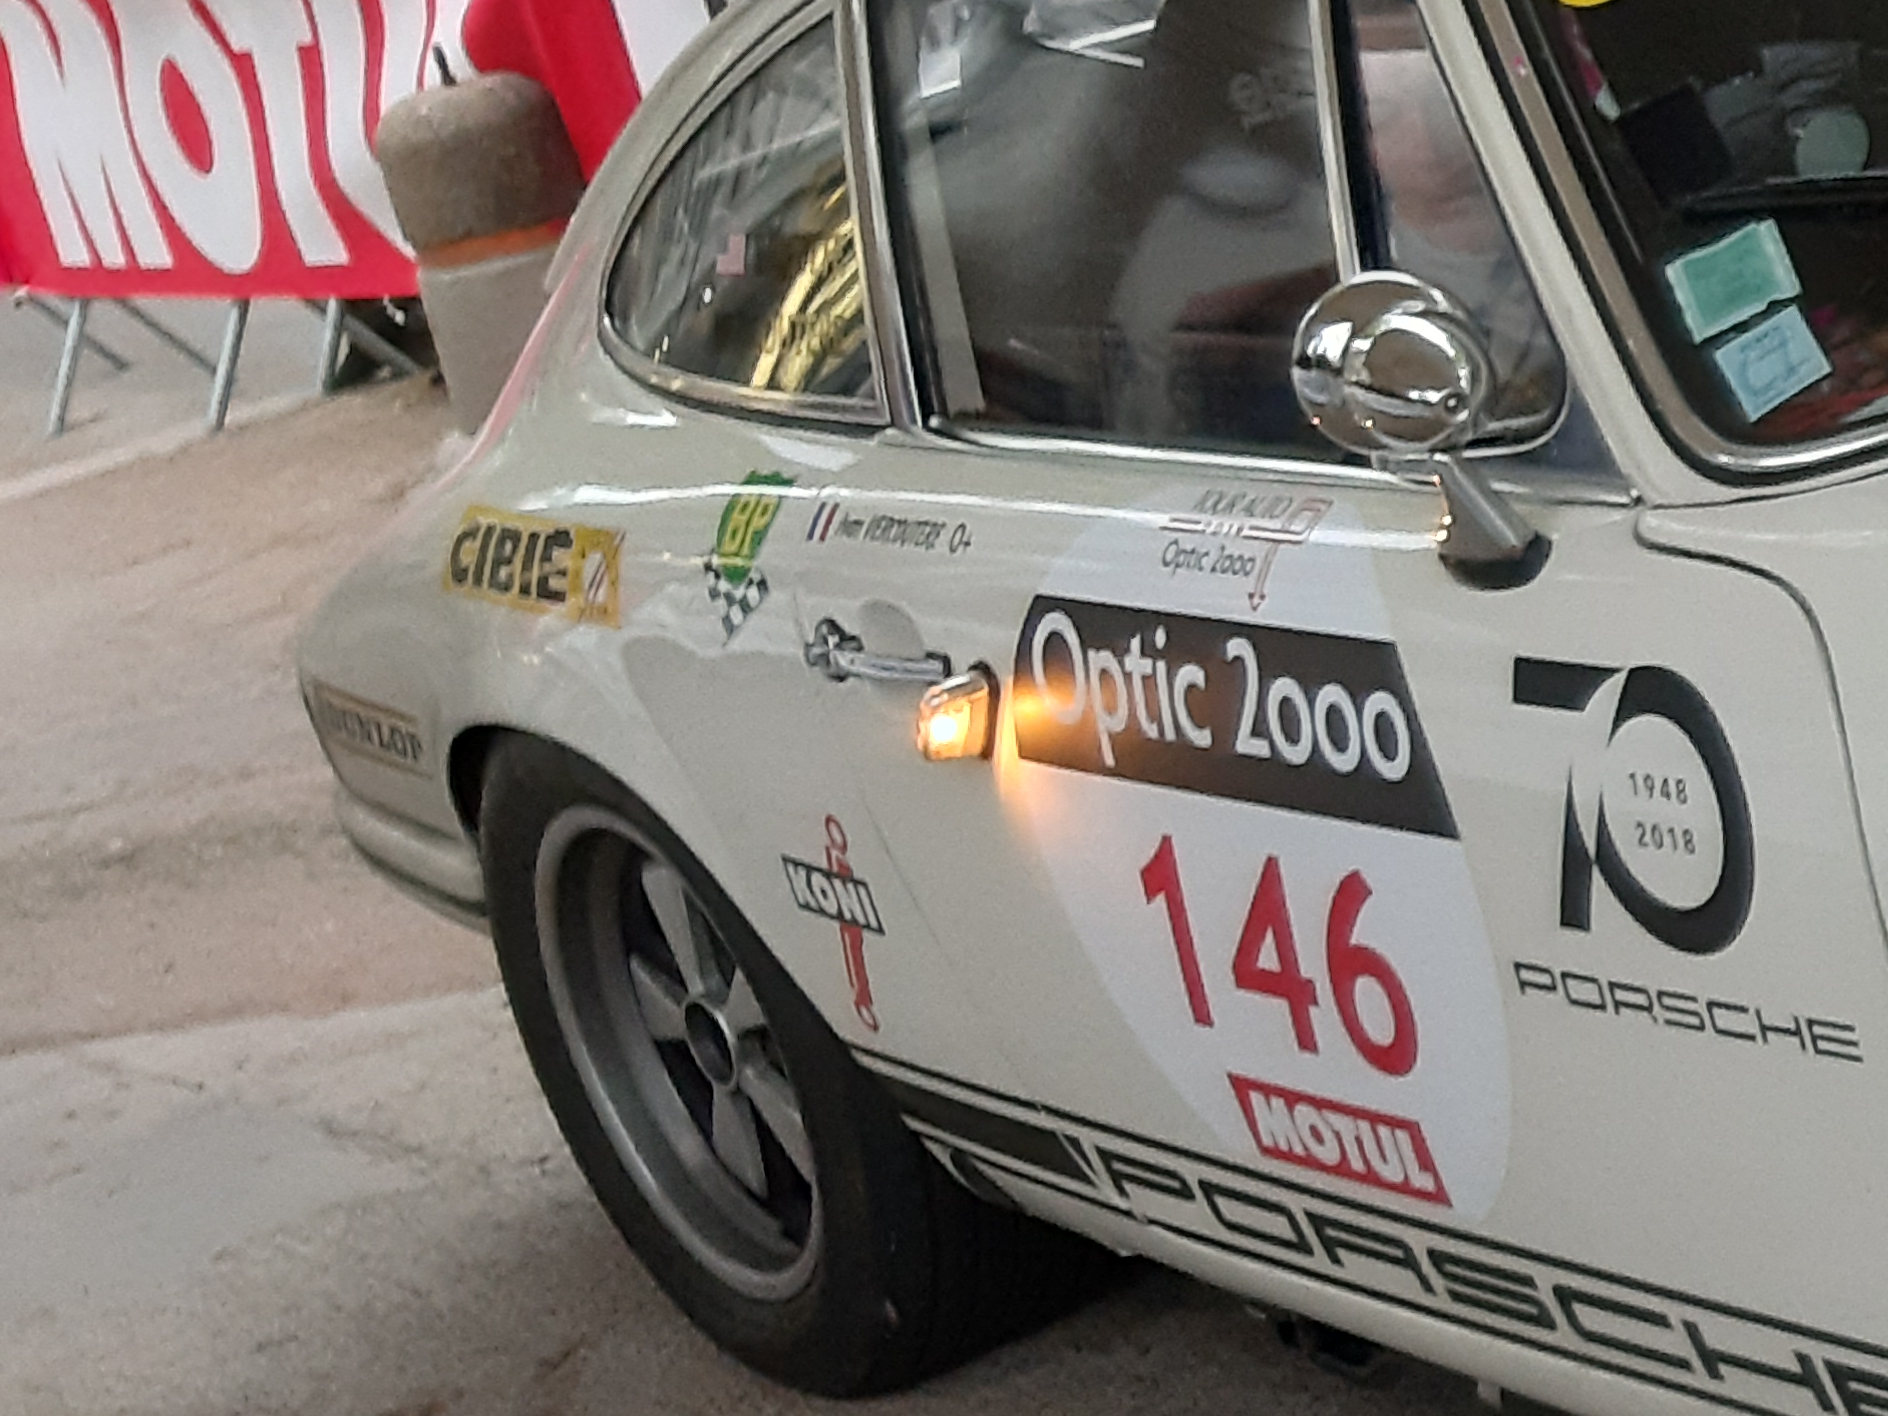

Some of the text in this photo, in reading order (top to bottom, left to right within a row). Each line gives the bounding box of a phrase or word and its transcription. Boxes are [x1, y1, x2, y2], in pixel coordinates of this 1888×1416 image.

[720, 493, 779, 557] BP
[1031, 609, 1412, 781] Optic 2000
[1512, 655, 1756, 956] 70
[1628, 772, 1688, 804] 1948
[1635, 820, 1696, 855] 2018
[785, 863, 881, 930] KONI
[1139, 833, 1420, 1078] 146
[1512, 960, 1864, 1064] PORSCHE
[1251, 1088, 1436, 1193] MOTUL
